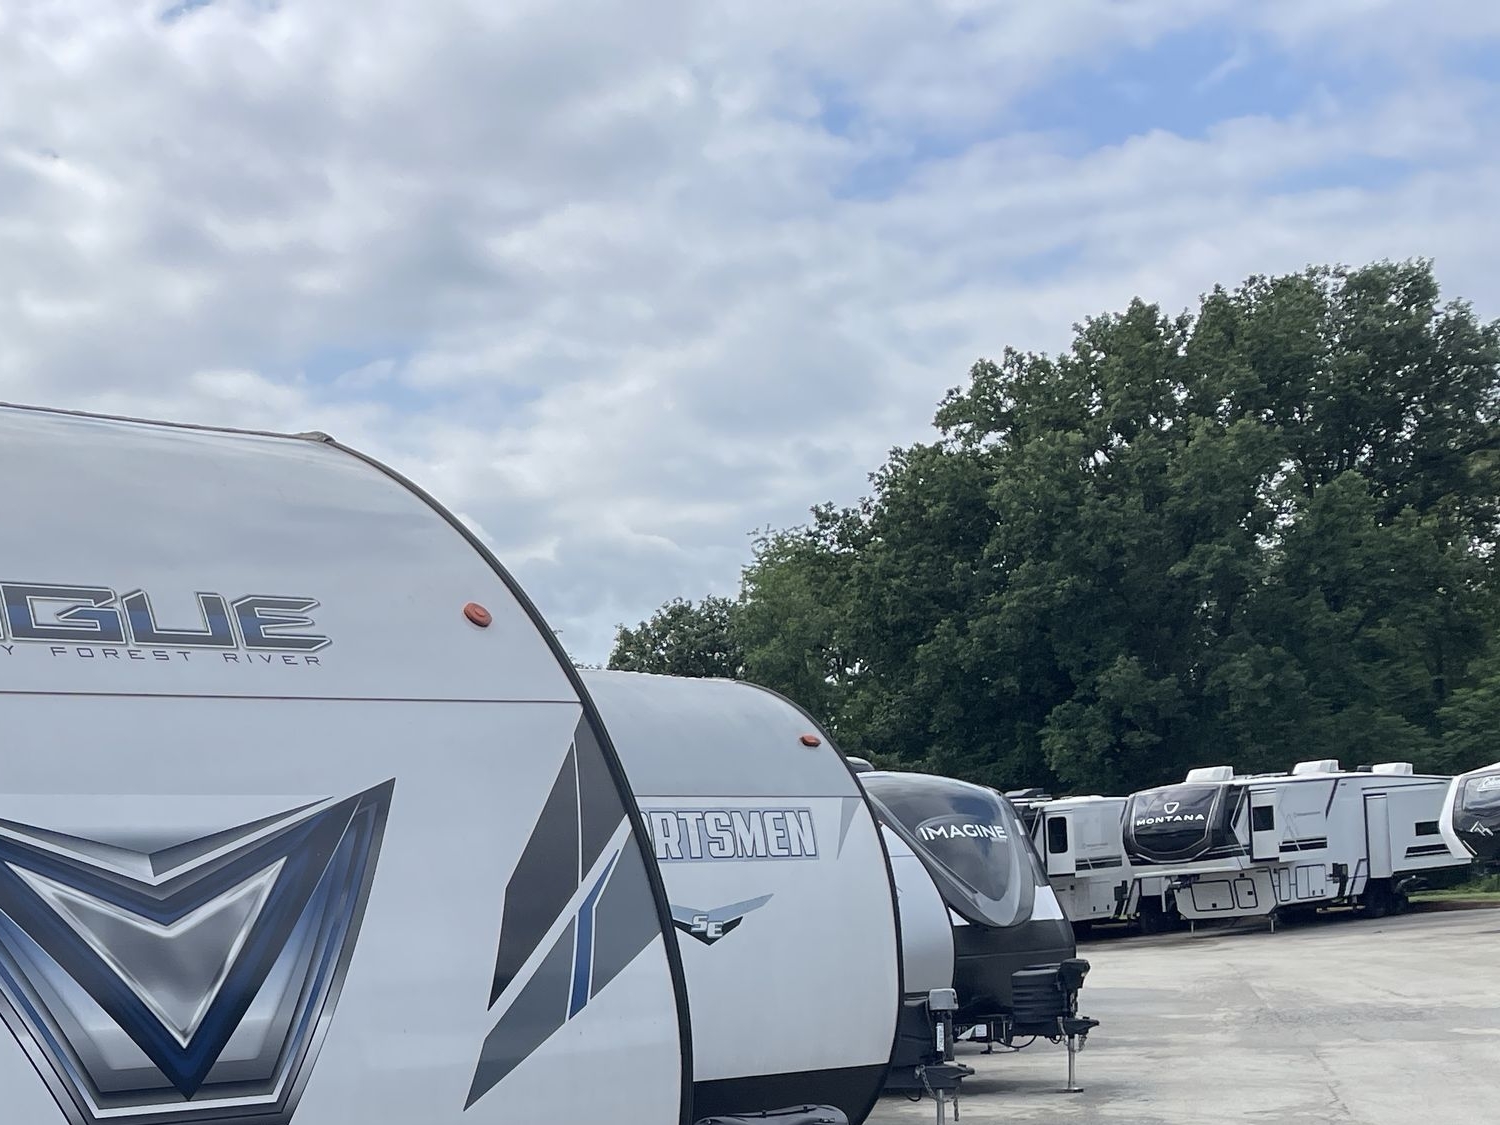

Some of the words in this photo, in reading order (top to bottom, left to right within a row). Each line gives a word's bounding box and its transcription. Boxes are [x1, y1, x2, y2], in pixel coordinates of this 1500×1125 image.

[49, 646, 192, 662] FOREST
[222, 652, 323, 666] RIVER
[1136, 813, 1205, 827] MONTANA
[919, 824, 1008, 841] IMAGINE
[691, 914, 724, 938] SE
